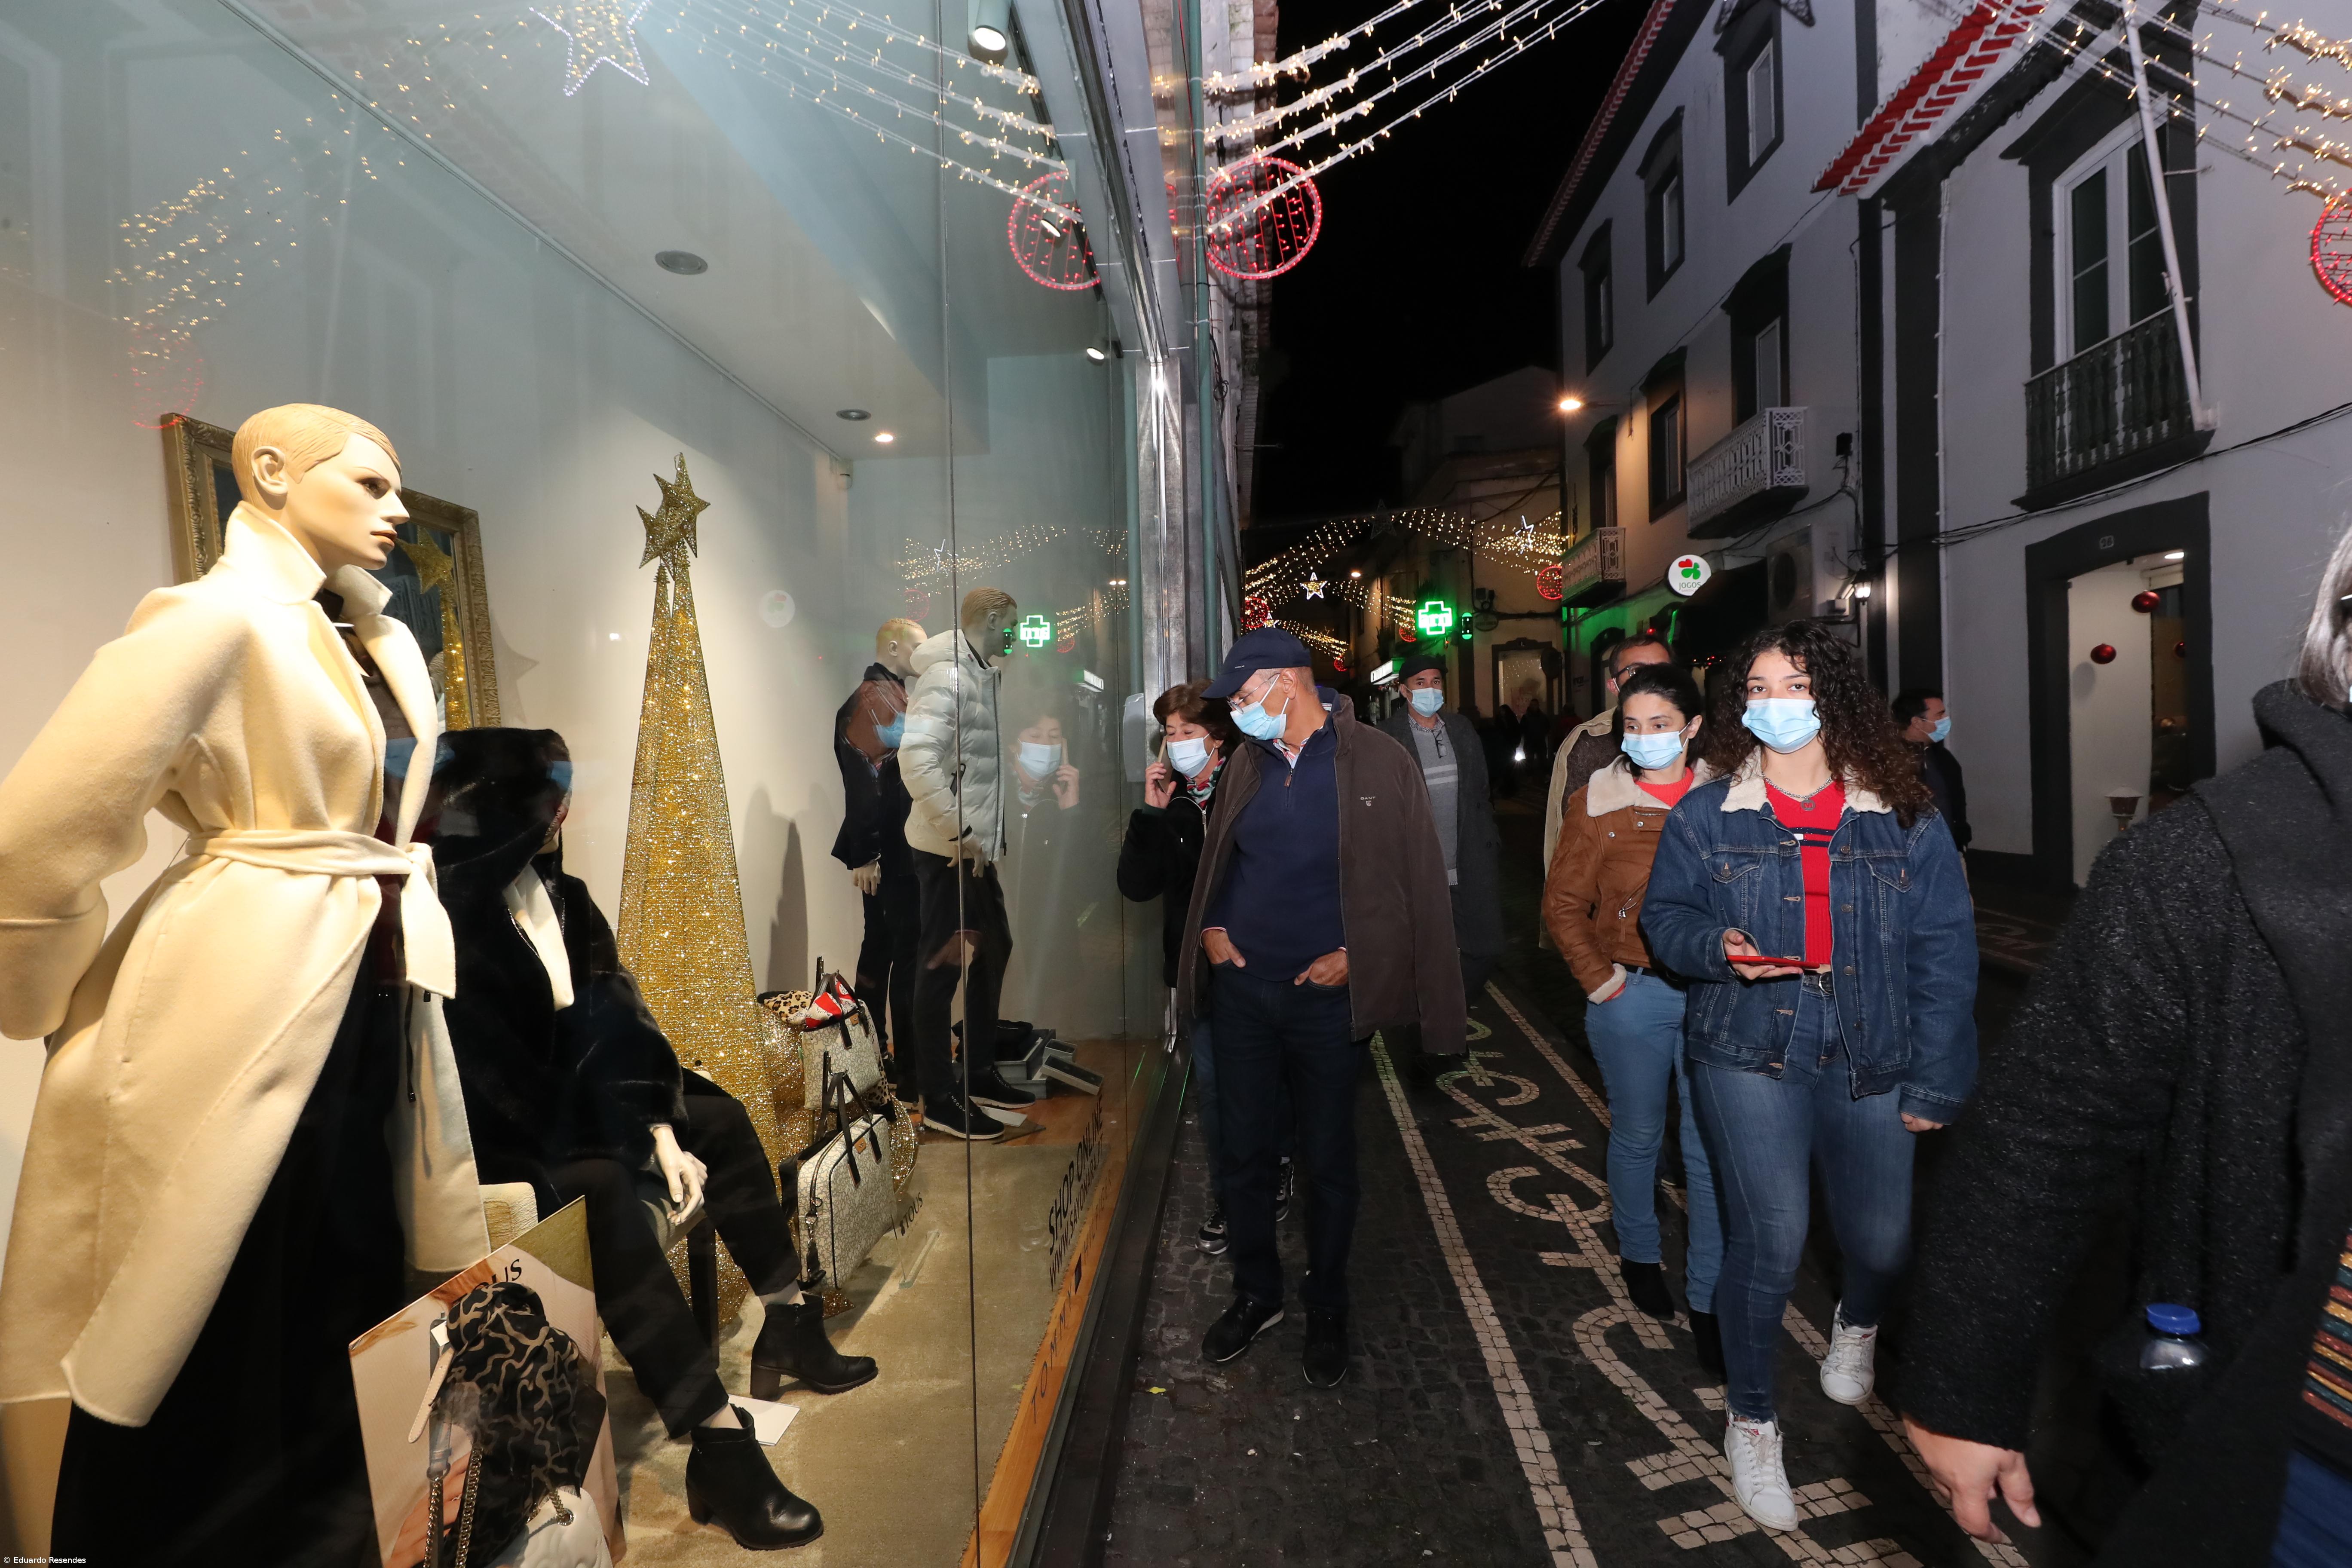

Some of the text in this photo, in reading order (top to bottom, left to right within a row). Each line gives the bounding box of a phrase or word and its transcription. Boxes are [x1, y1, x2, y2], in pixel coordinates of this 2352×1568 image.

[1679, 582, 1701, 591] JOGOS
[903, 1192, 923, 1228] TOUS
[1049, 1094, 1103, 1255] SHOP ONLINE
[1049, 1133, 1103, 1292] WWW.SAYONARA.PT
[1032, 1168, 1112, 1424] TOMMY HILFIGER
